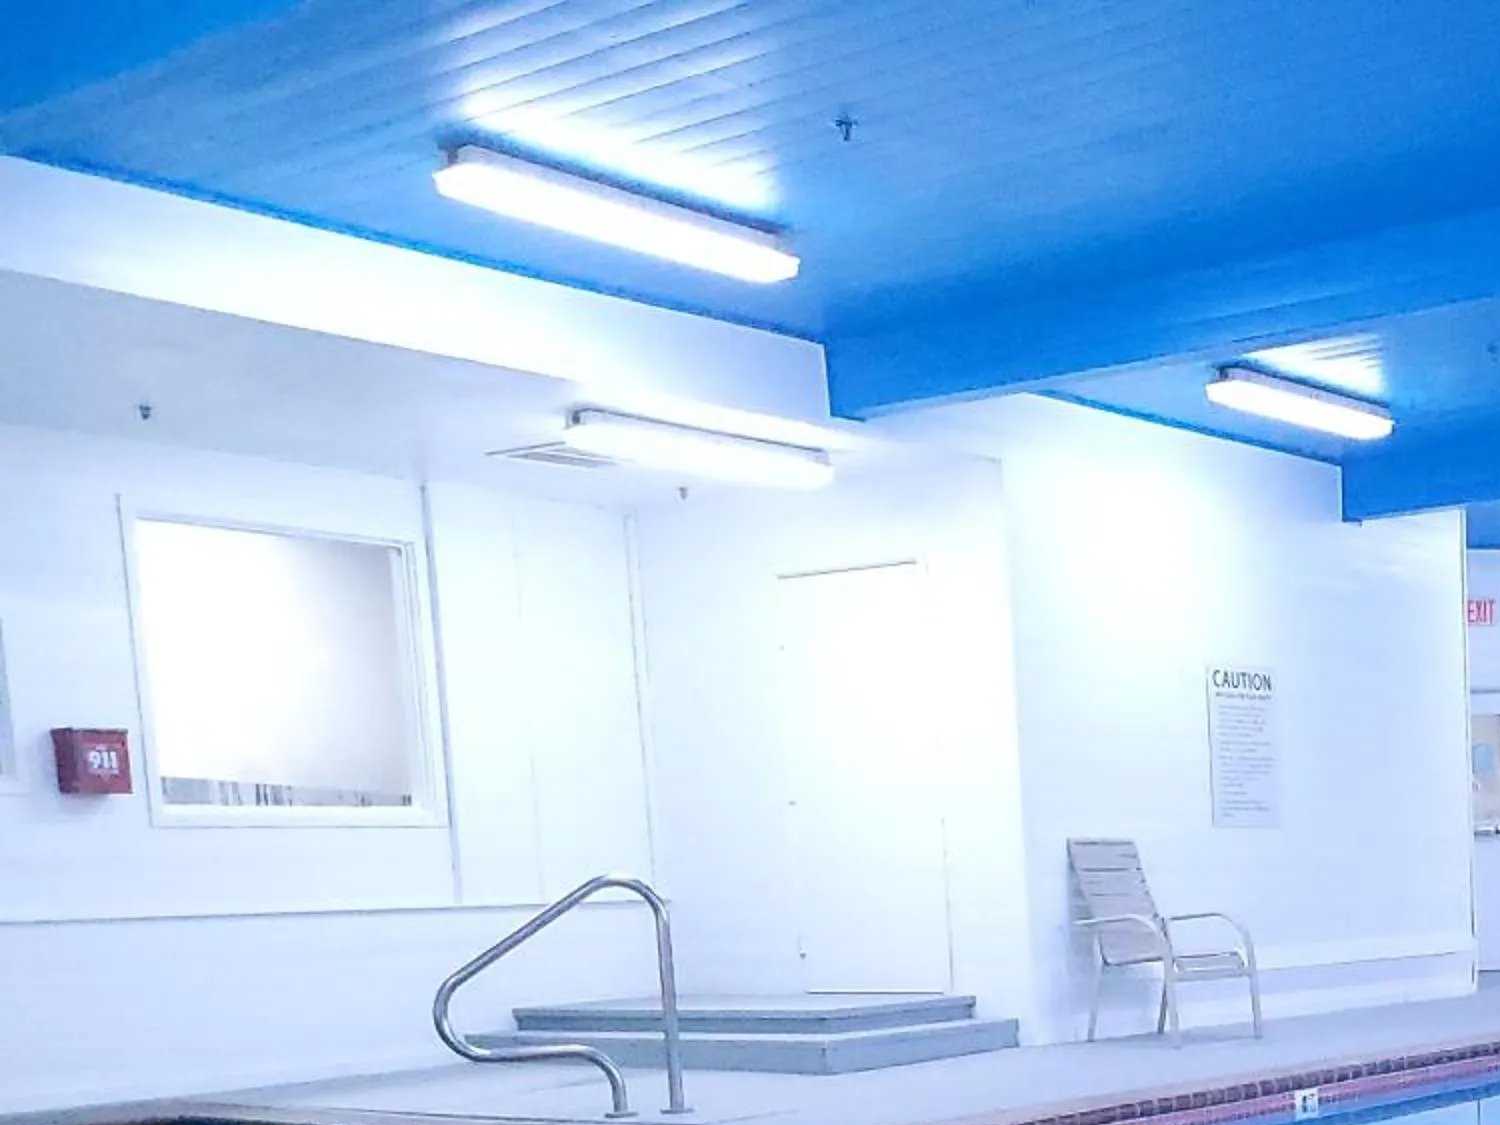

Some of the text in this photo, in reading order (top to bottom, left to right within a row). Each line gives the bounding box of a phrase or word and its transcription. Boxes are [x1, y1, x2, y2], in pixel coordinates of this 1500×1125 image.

[1467, 599, 1496, 625] EXIT
[1211, 669, 1273, 691] CAUTION
[88, 751, 118, 769] 911
